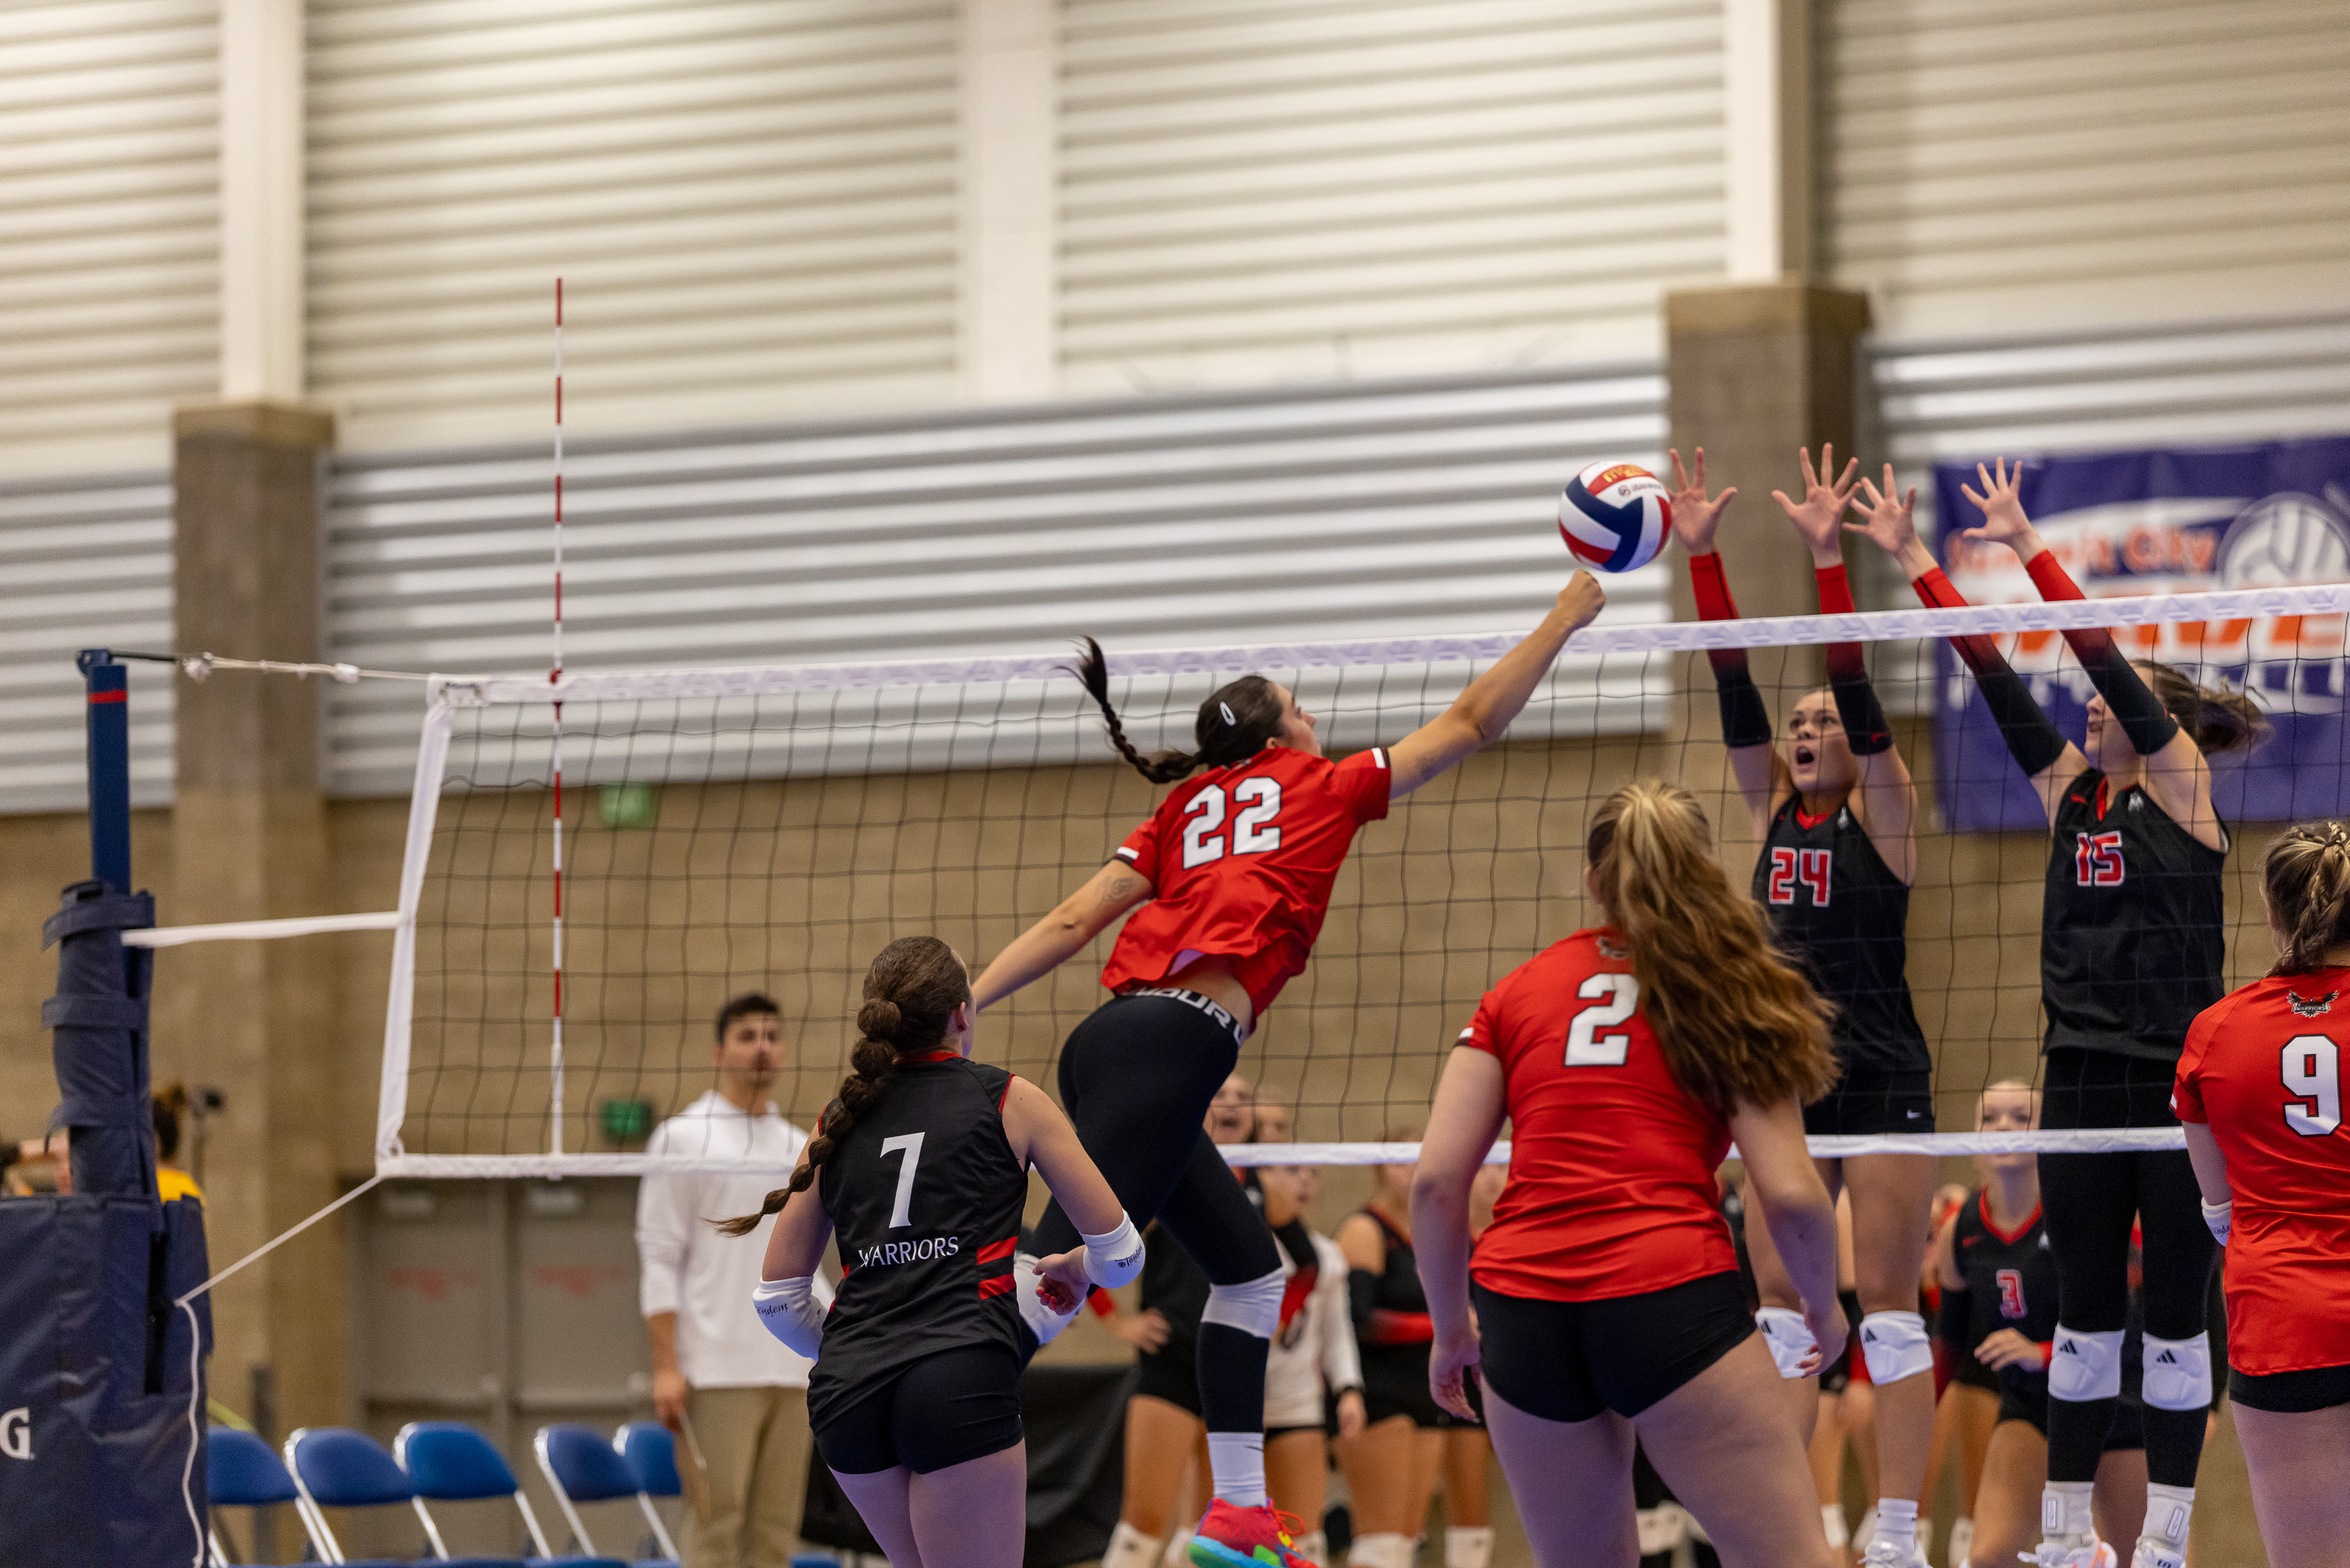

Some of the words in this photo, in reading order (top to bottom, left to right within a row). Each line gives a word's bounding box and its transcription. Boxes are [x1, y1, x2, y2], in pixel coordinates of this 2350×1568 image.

[1183, 776, 1282, 871] 22
[2076, 830, 2125, 886] 15
[1769, 846, 1832, 907] 24
[1563, 972, 1639, 1068] 2
[2280, 1034, 2343, 1138] 9
[880, 1131, 925, 1229] 7
[858, 1236, 959, 1268] WARRIORS
[1996, 1268, 2027, 1319] 3
